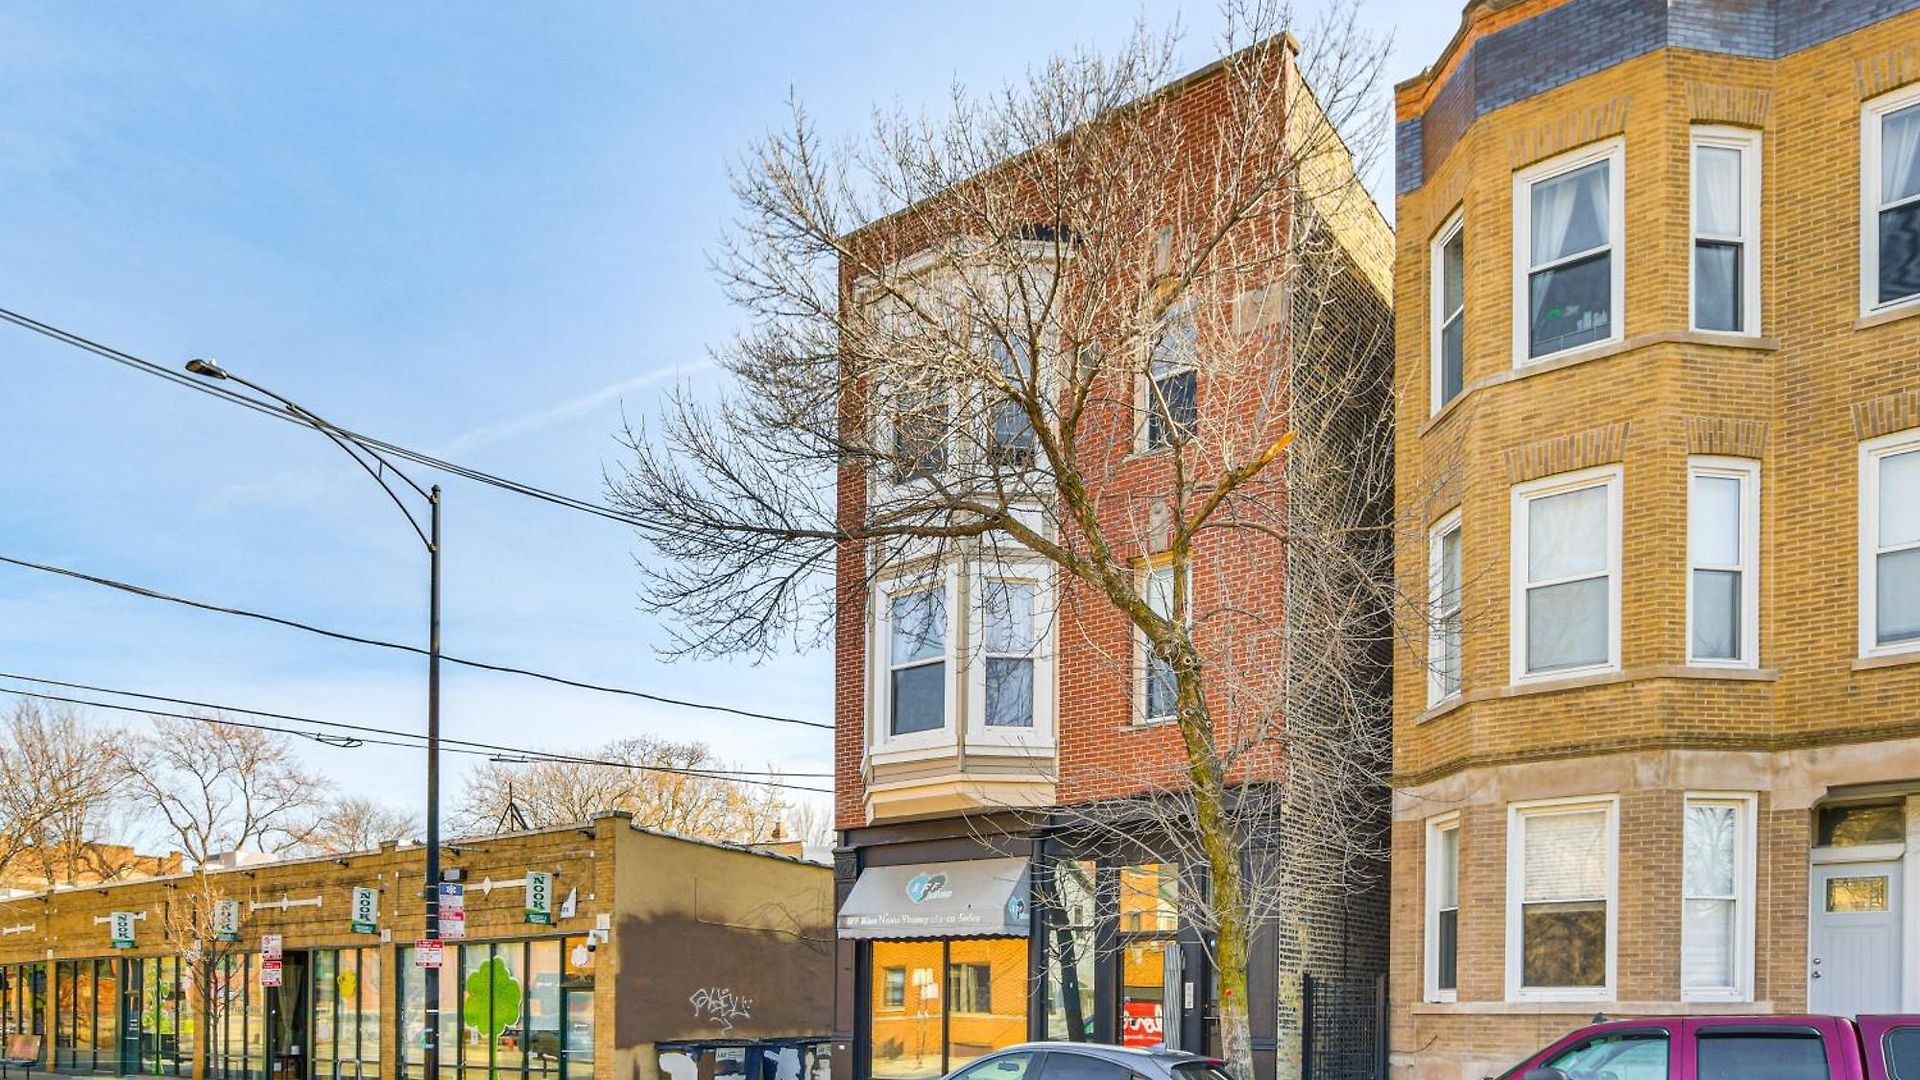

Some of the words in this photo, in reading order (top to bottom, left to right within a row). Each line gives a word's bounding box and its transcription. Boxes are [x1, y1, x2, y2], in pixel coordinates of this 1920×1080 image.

[360, 890, 371, 921] NOOK
[533, 876, 546, 910] NOOK
[117, 914, 129, 939] NOOK
